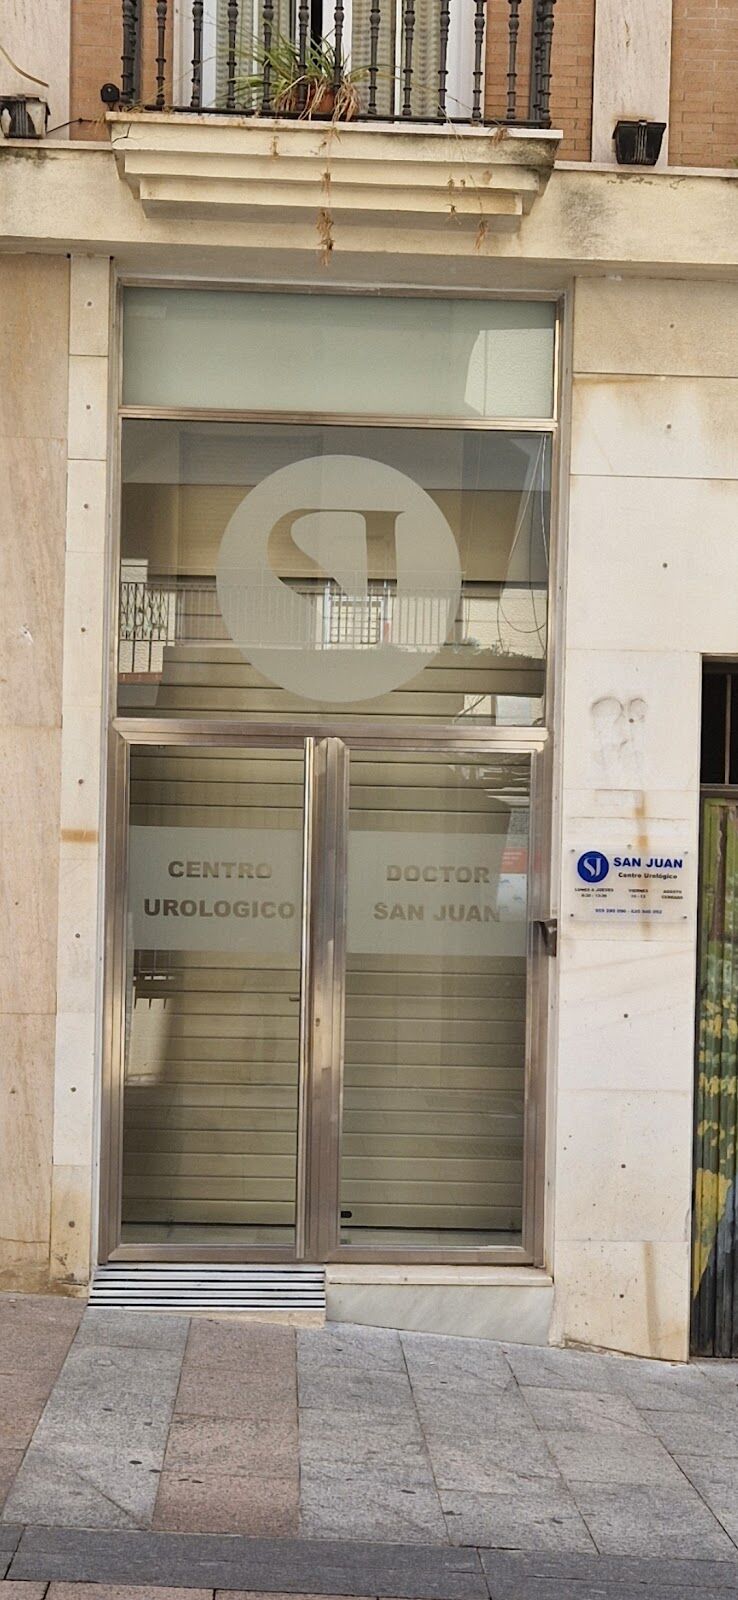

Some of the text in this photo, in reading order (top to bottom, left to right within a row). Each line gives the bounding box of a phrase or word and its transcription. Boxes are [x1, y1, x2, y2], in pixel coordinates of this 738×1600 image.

[167, 860, 273, 879] CENTRO
[613, 857, 683, 868] SAN JUAN
[386, 864, 490, 883] DOCTOR
[643, 872, 678, 880] Urológico
[143, 898, 296, 919] UROLOGICO
[372, 902, 501, 923] SAN JUAN
